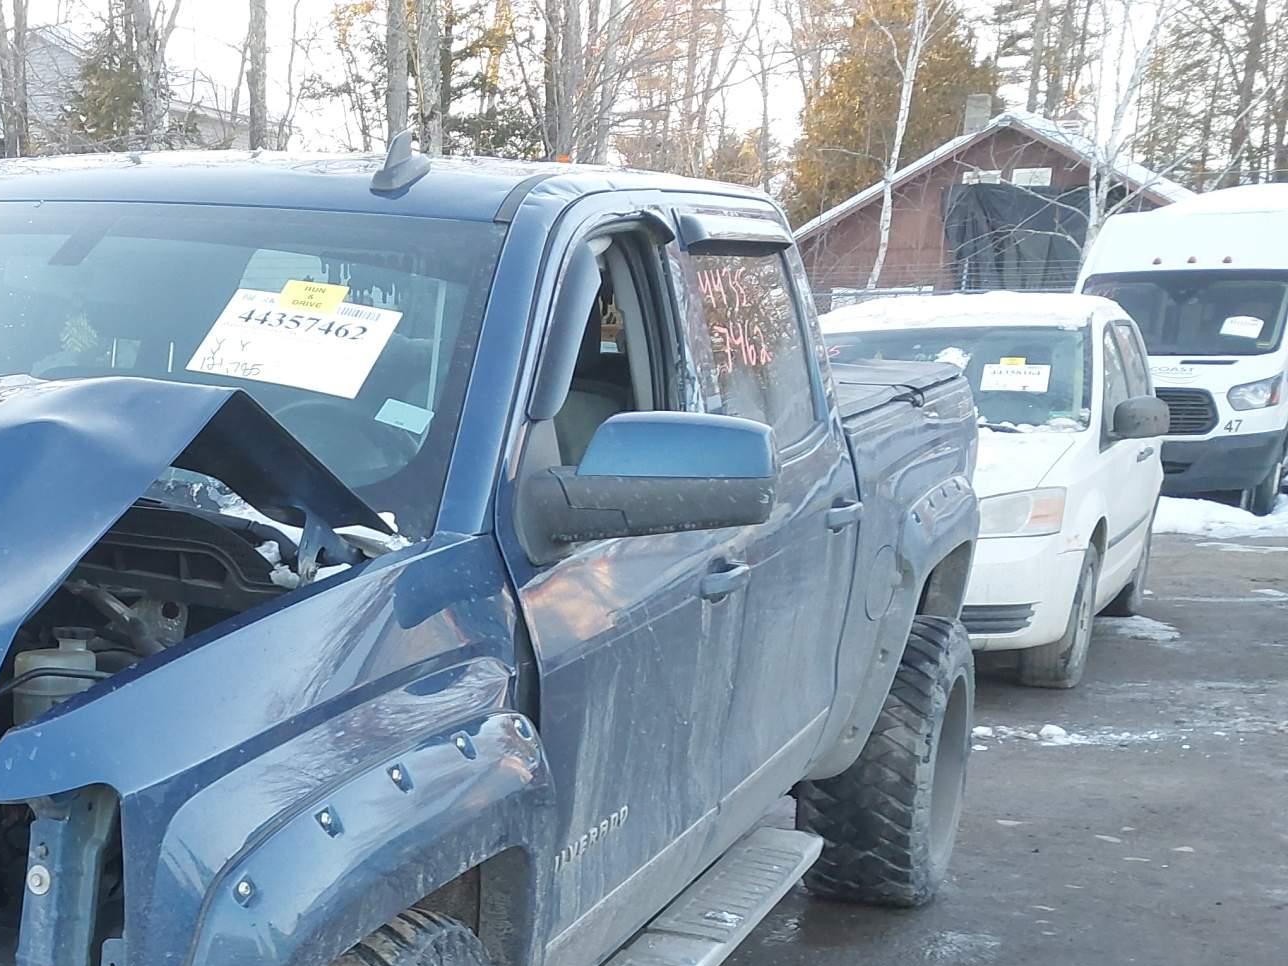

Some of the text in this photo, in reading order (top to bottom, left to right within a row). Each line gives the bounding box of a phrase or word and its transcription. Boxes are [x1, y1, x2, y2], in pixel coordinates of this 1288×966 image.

[304, 285, 327, 294] RUN
[291, 299, 323, 309] DRIVE
[238, 308, 368, 340] 44357462
[1224, 419, 1243, 433] 47
